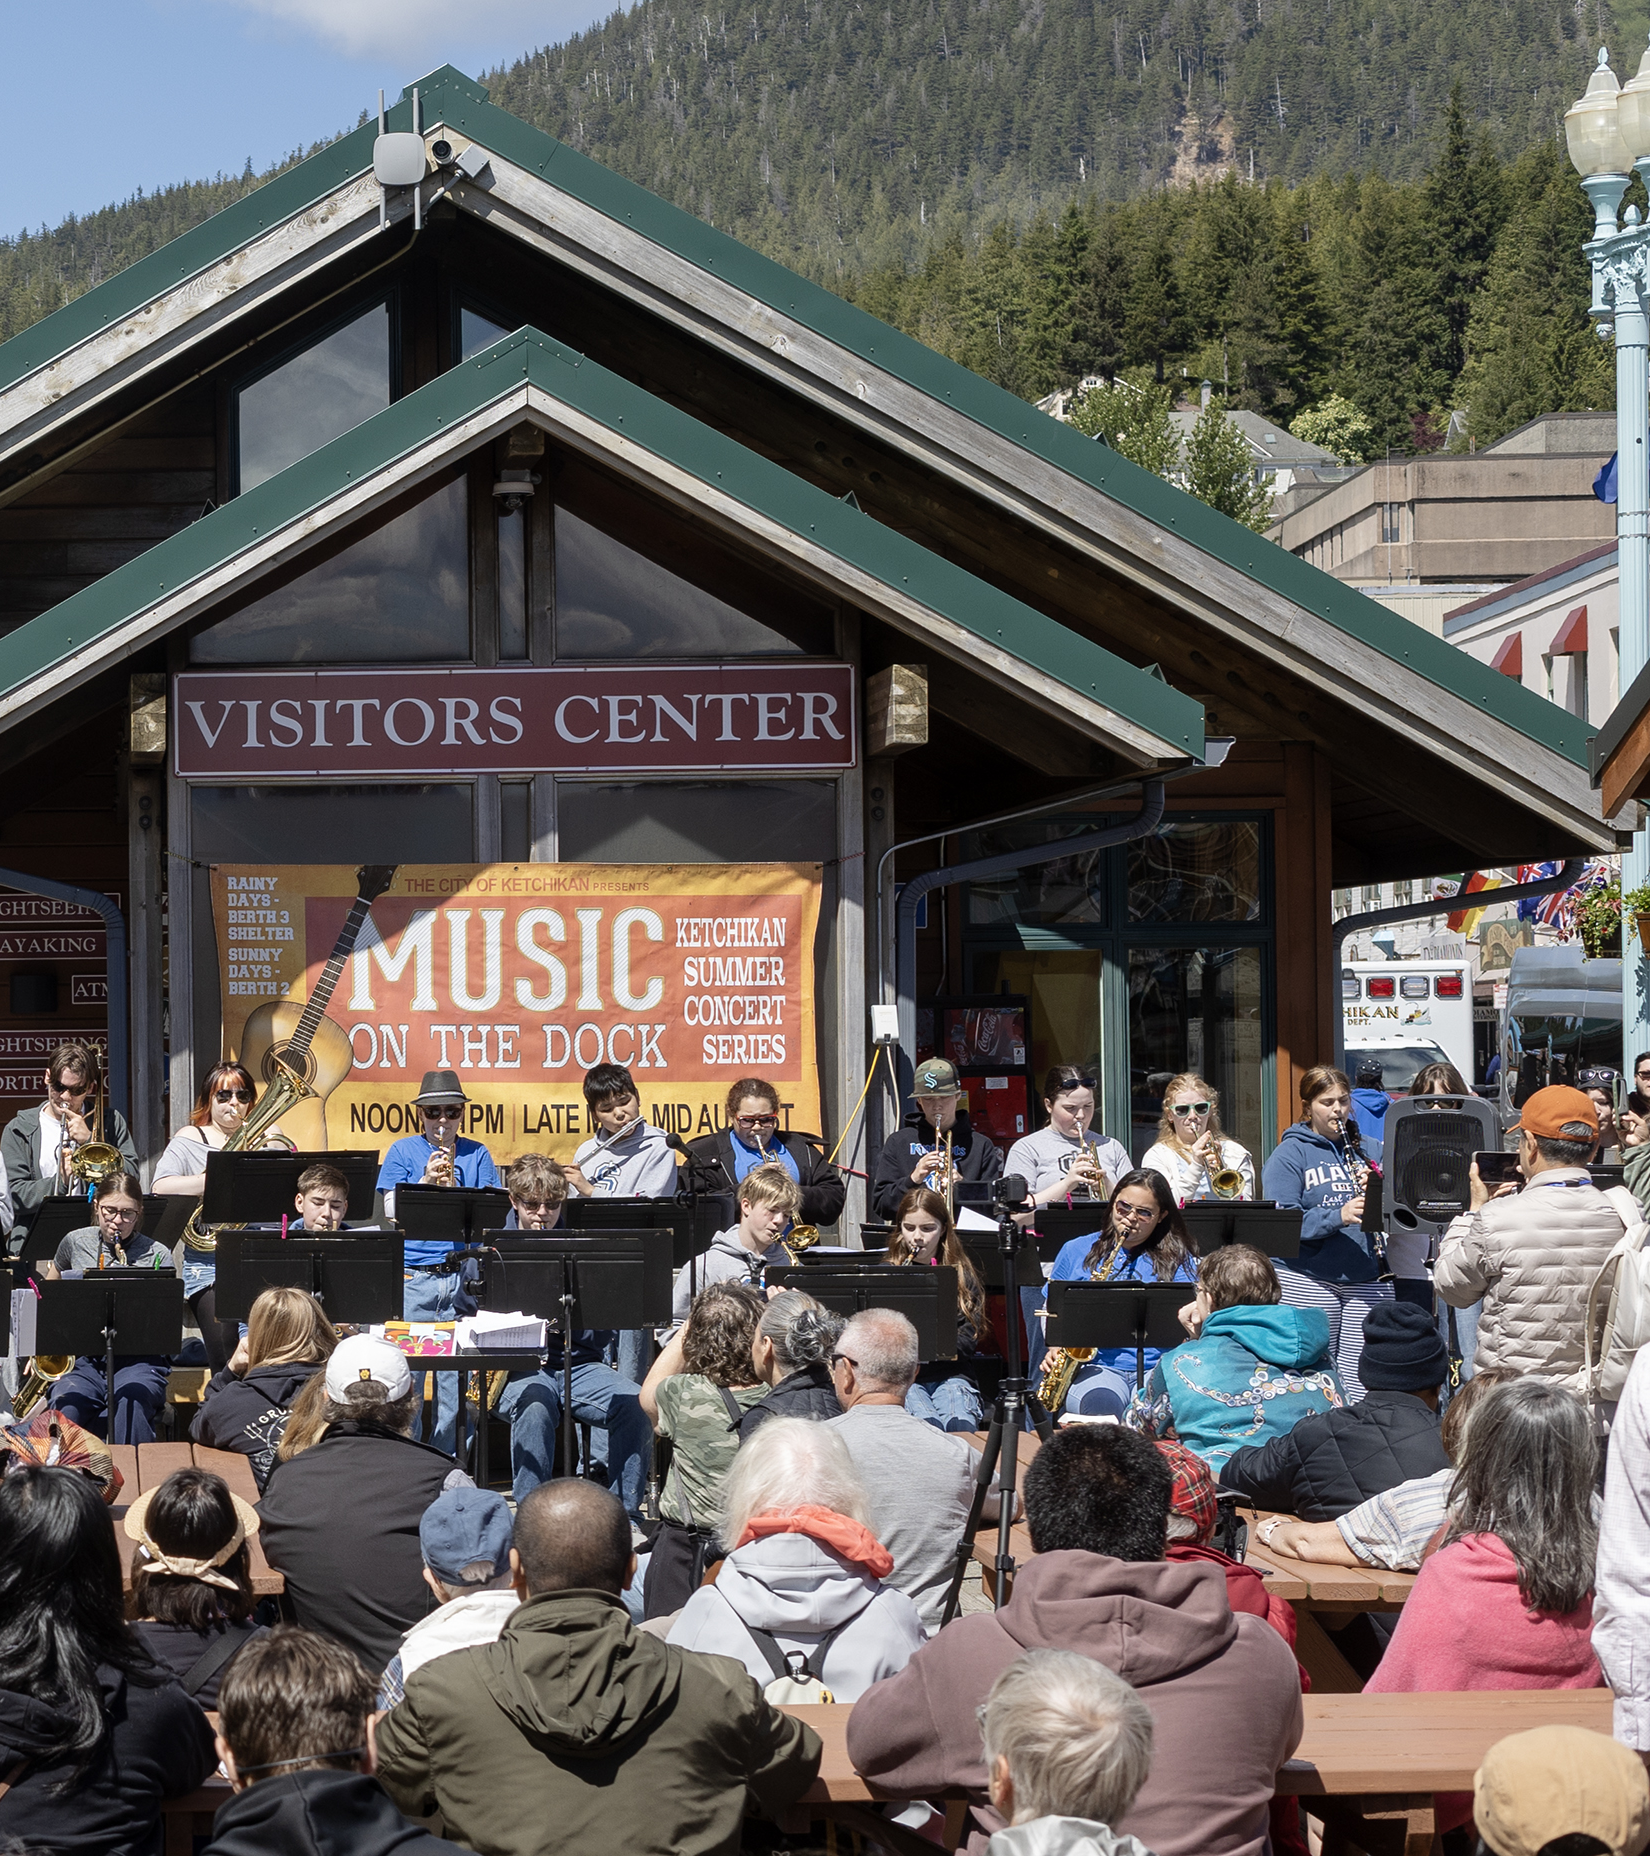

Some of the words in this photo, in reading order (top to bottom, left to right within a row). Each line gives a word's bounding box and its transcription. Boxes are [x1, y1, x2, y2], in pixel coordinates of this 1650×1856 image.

[184, 696, 524, 749] VISITORS
[554, 692, 846, 744] CENTER
[227, 876, 278, 890] RAINY
[404, 878, 435, 893] THE
[438, 878, 472, 893] CITY
[476, 877, 497, 892] OF
[501, 877, 590, 892] KETCHIKAN
[593, 881, 650, 892] PRESENTS
[227, 893, 271, 907] DAYS
[228, 910, 277, 924] BERTH
[279, 910, 290, 924] 3
[228, 927, 294, 941] SHELTER
[675, 917, 787, 948] KETCHIKAN
[228, 947, 284, 962] SUNNY
[346, 906, 666, 1012] MUSIC
[229, 964, 272, 978] DAYS
[683, 956, 786, 988] SUMMER
[229, 981, 278, 995] BERTH
[280, 981, 290, 995] 2
[683, 994, 786, 1027] CONCERT
[1343, 1006, 1400, 1019] HIKAN
[349, 1022, 410, 1069] ON
[429, 1023, 522, 1068] THE
[542, 1022, 668, 1069] DOCK
[702, 1033, 787, 1065] SERIES
[350, 1103, 420, 1133] NOON
[523, 1104, 580, 1134] LATE
[652, 1103, 693, 1134] MID
